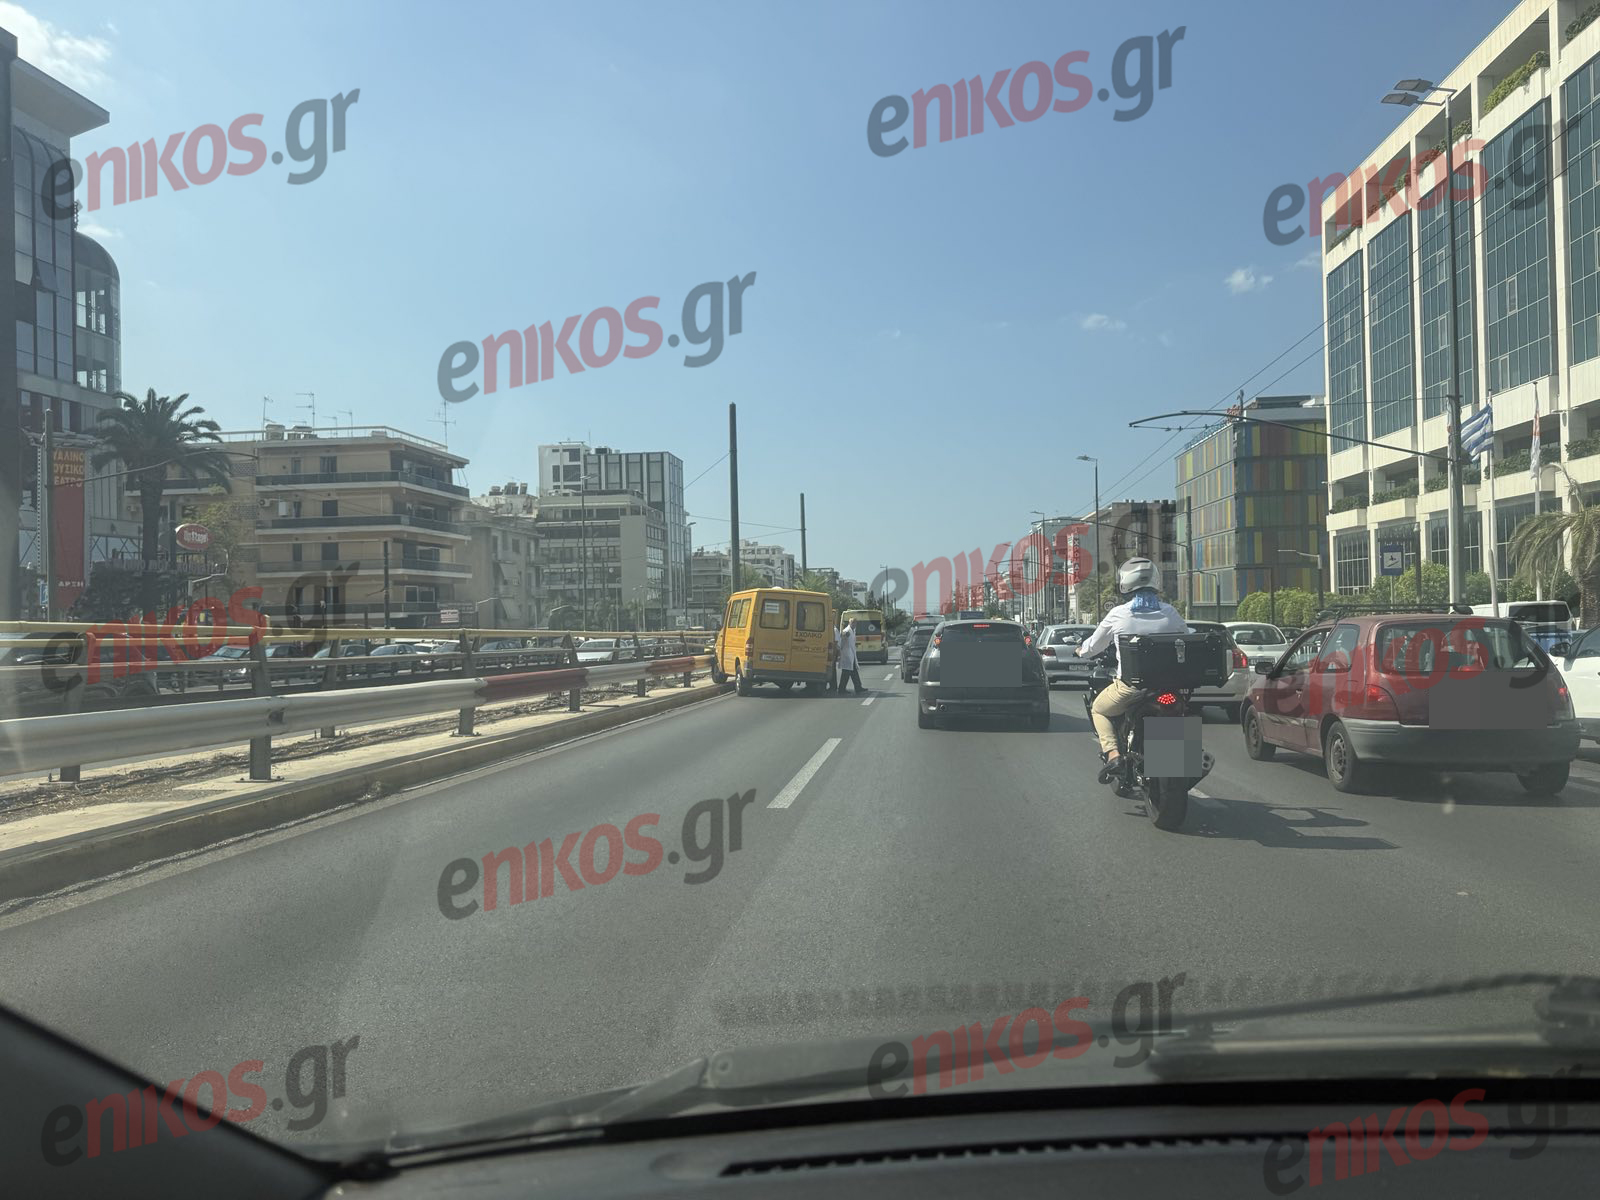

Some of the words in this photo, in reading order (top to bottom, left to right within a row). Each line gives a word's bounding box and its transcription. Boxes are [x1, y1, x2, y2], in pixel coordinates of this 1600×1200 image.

[53, 449, 84, 463] ΥΑΛΙΝΟ
[53, 463, 84, 475] ΟΥΣΙΚΟ
[54, 476, 83, 488] ΕΑΤΡΟ
